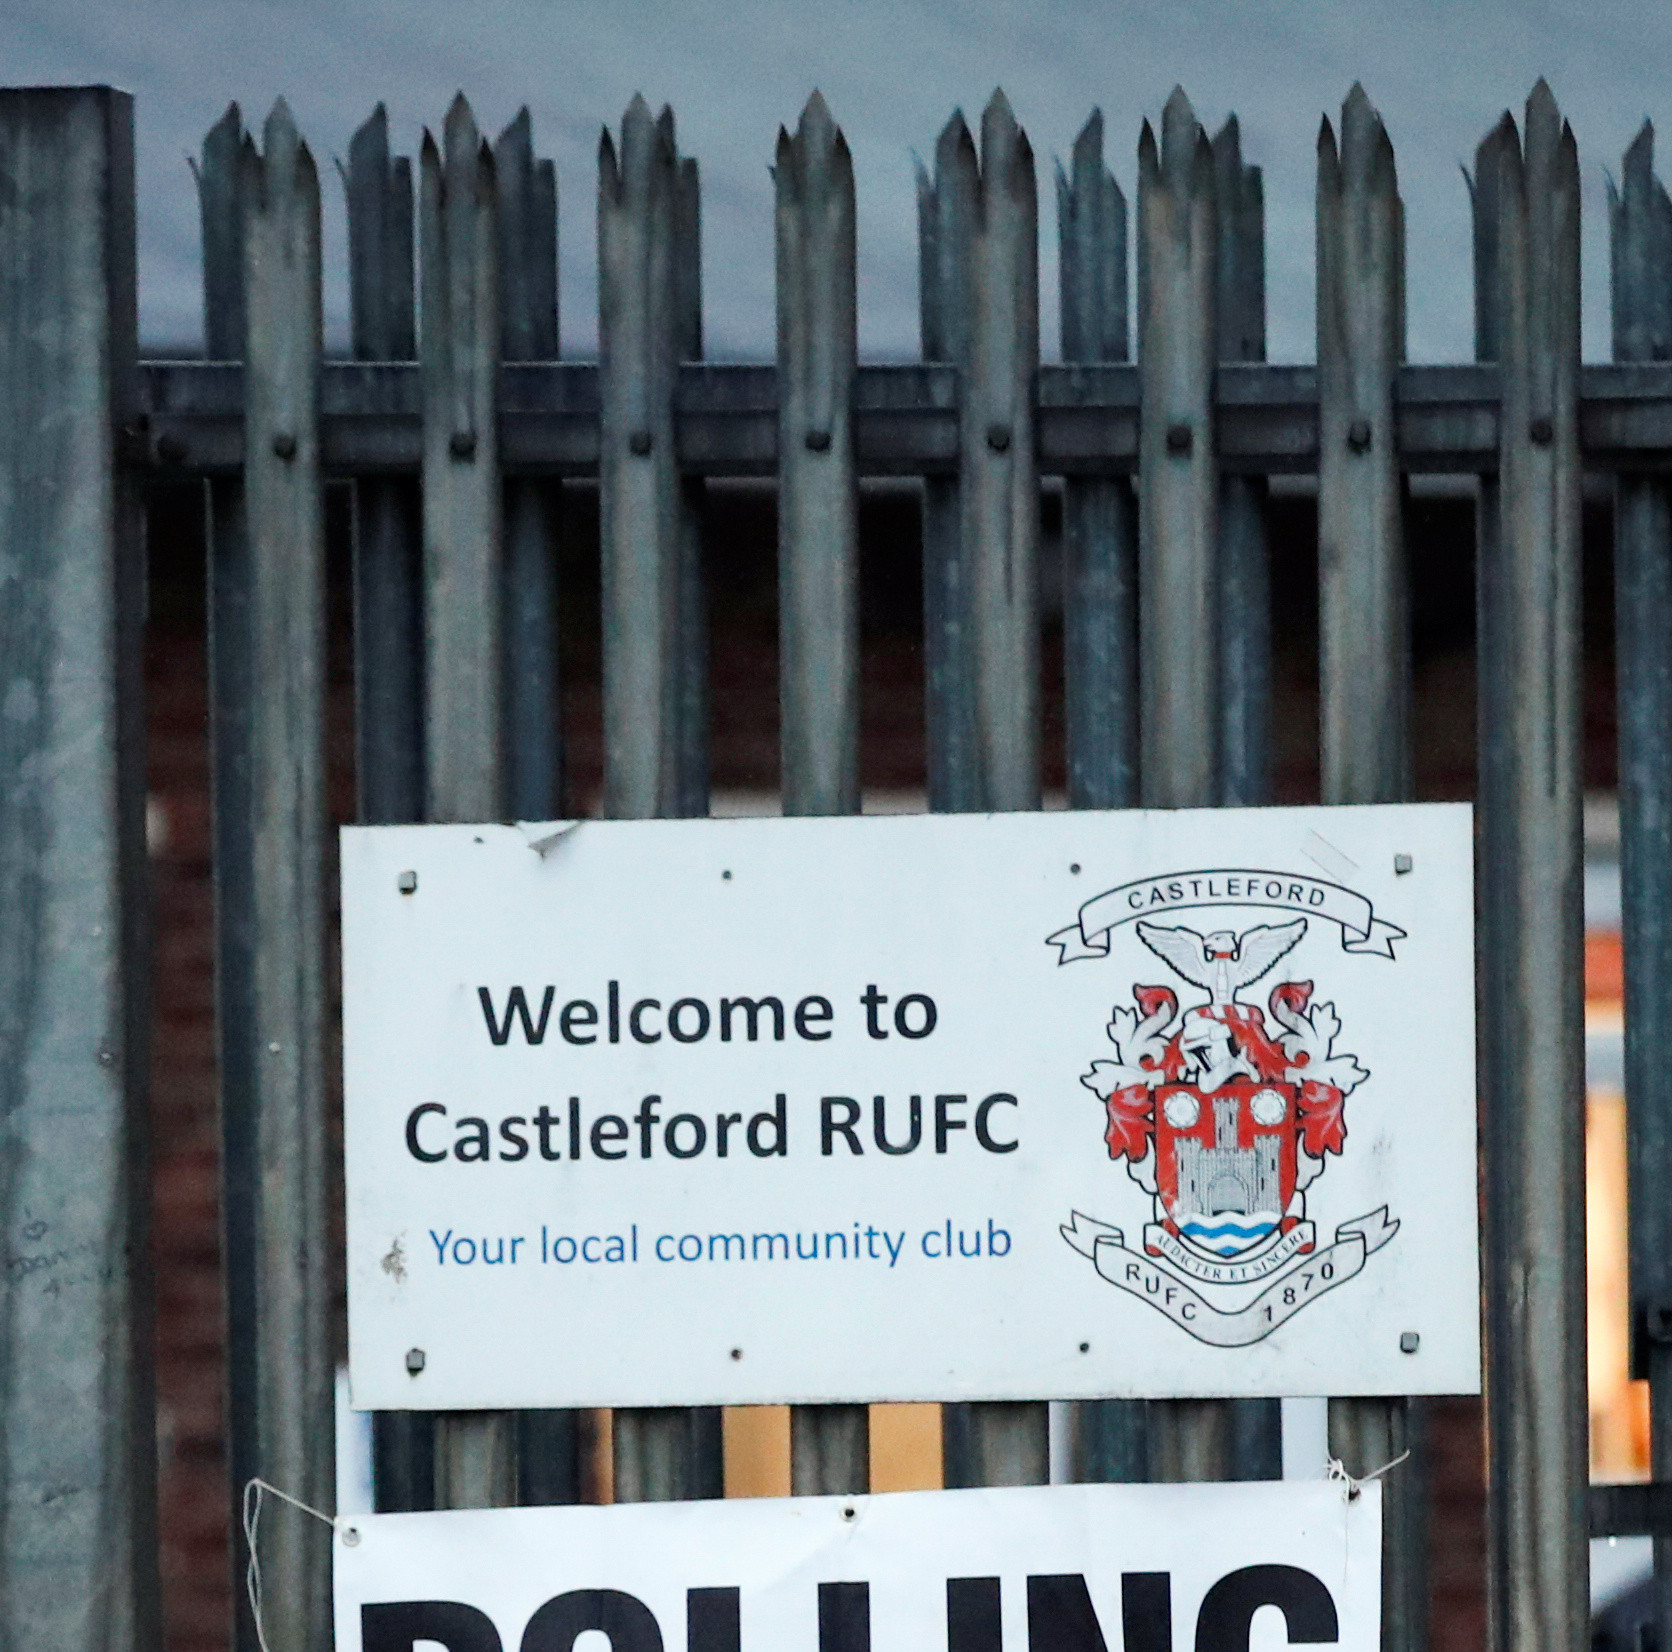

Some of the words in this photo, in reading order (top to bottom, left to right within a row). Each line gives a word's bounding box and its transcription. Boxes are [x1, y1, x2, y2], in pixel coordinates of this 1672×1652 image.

[1127, 878, 1326, 910] CASTLEFORD
[477, 979, 834, 1046] Welcome
[859, 984, 938, 1040] to
[405, 1093, 788, 1164] Castleford
[820, 1092, 1019, 1157] RUFC
[429, 1229, 525, 1266] Your
[541, 1224, 638, 1264] local
[655, 1221, 906, 1268] community
[921, 1218, 1012, 1258] club
[1125, 1262, 1197, 1321] RUFC
[1262, 1263, 1335, 1322] 1870
